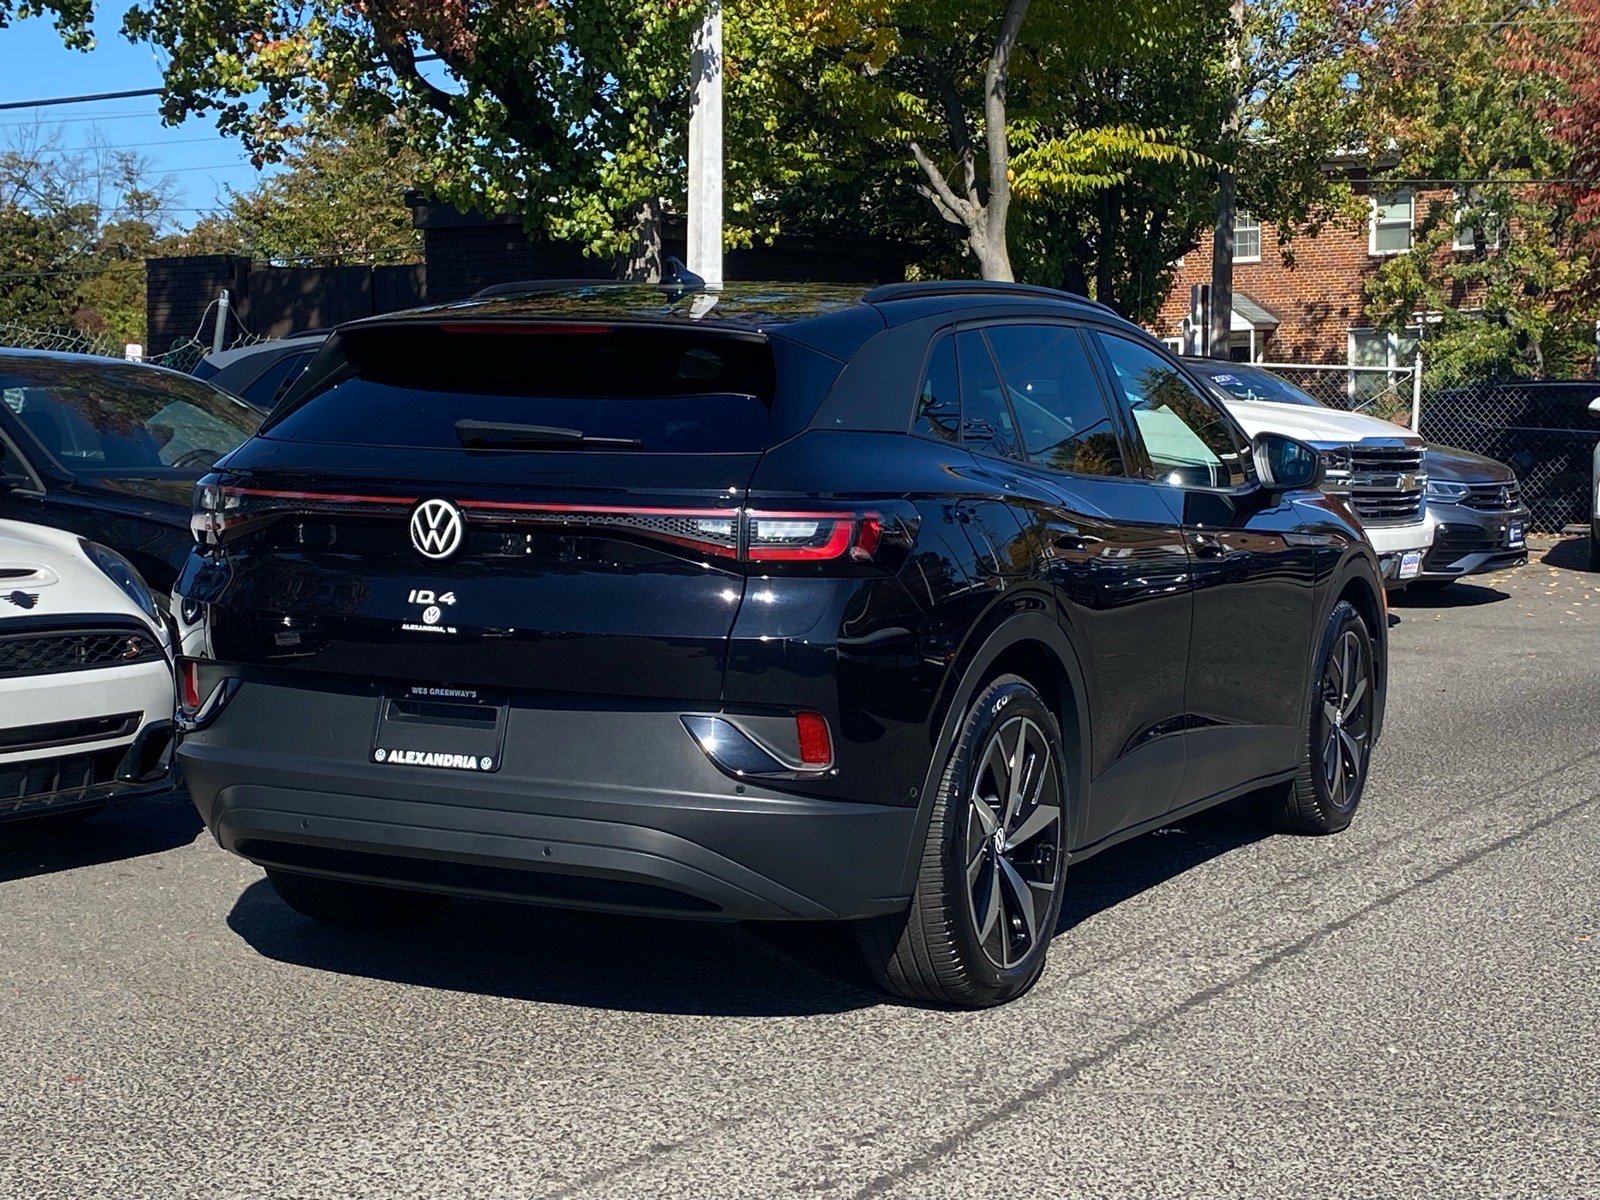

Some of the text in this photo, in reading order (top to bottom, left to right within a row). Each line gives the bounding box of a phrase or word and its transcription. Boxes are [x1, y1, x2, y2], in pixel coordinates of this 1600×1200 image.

[411, 686, 477, 698] WES GREENWAY'S
[387, 750, 477, 769] ALEXANDRIA
